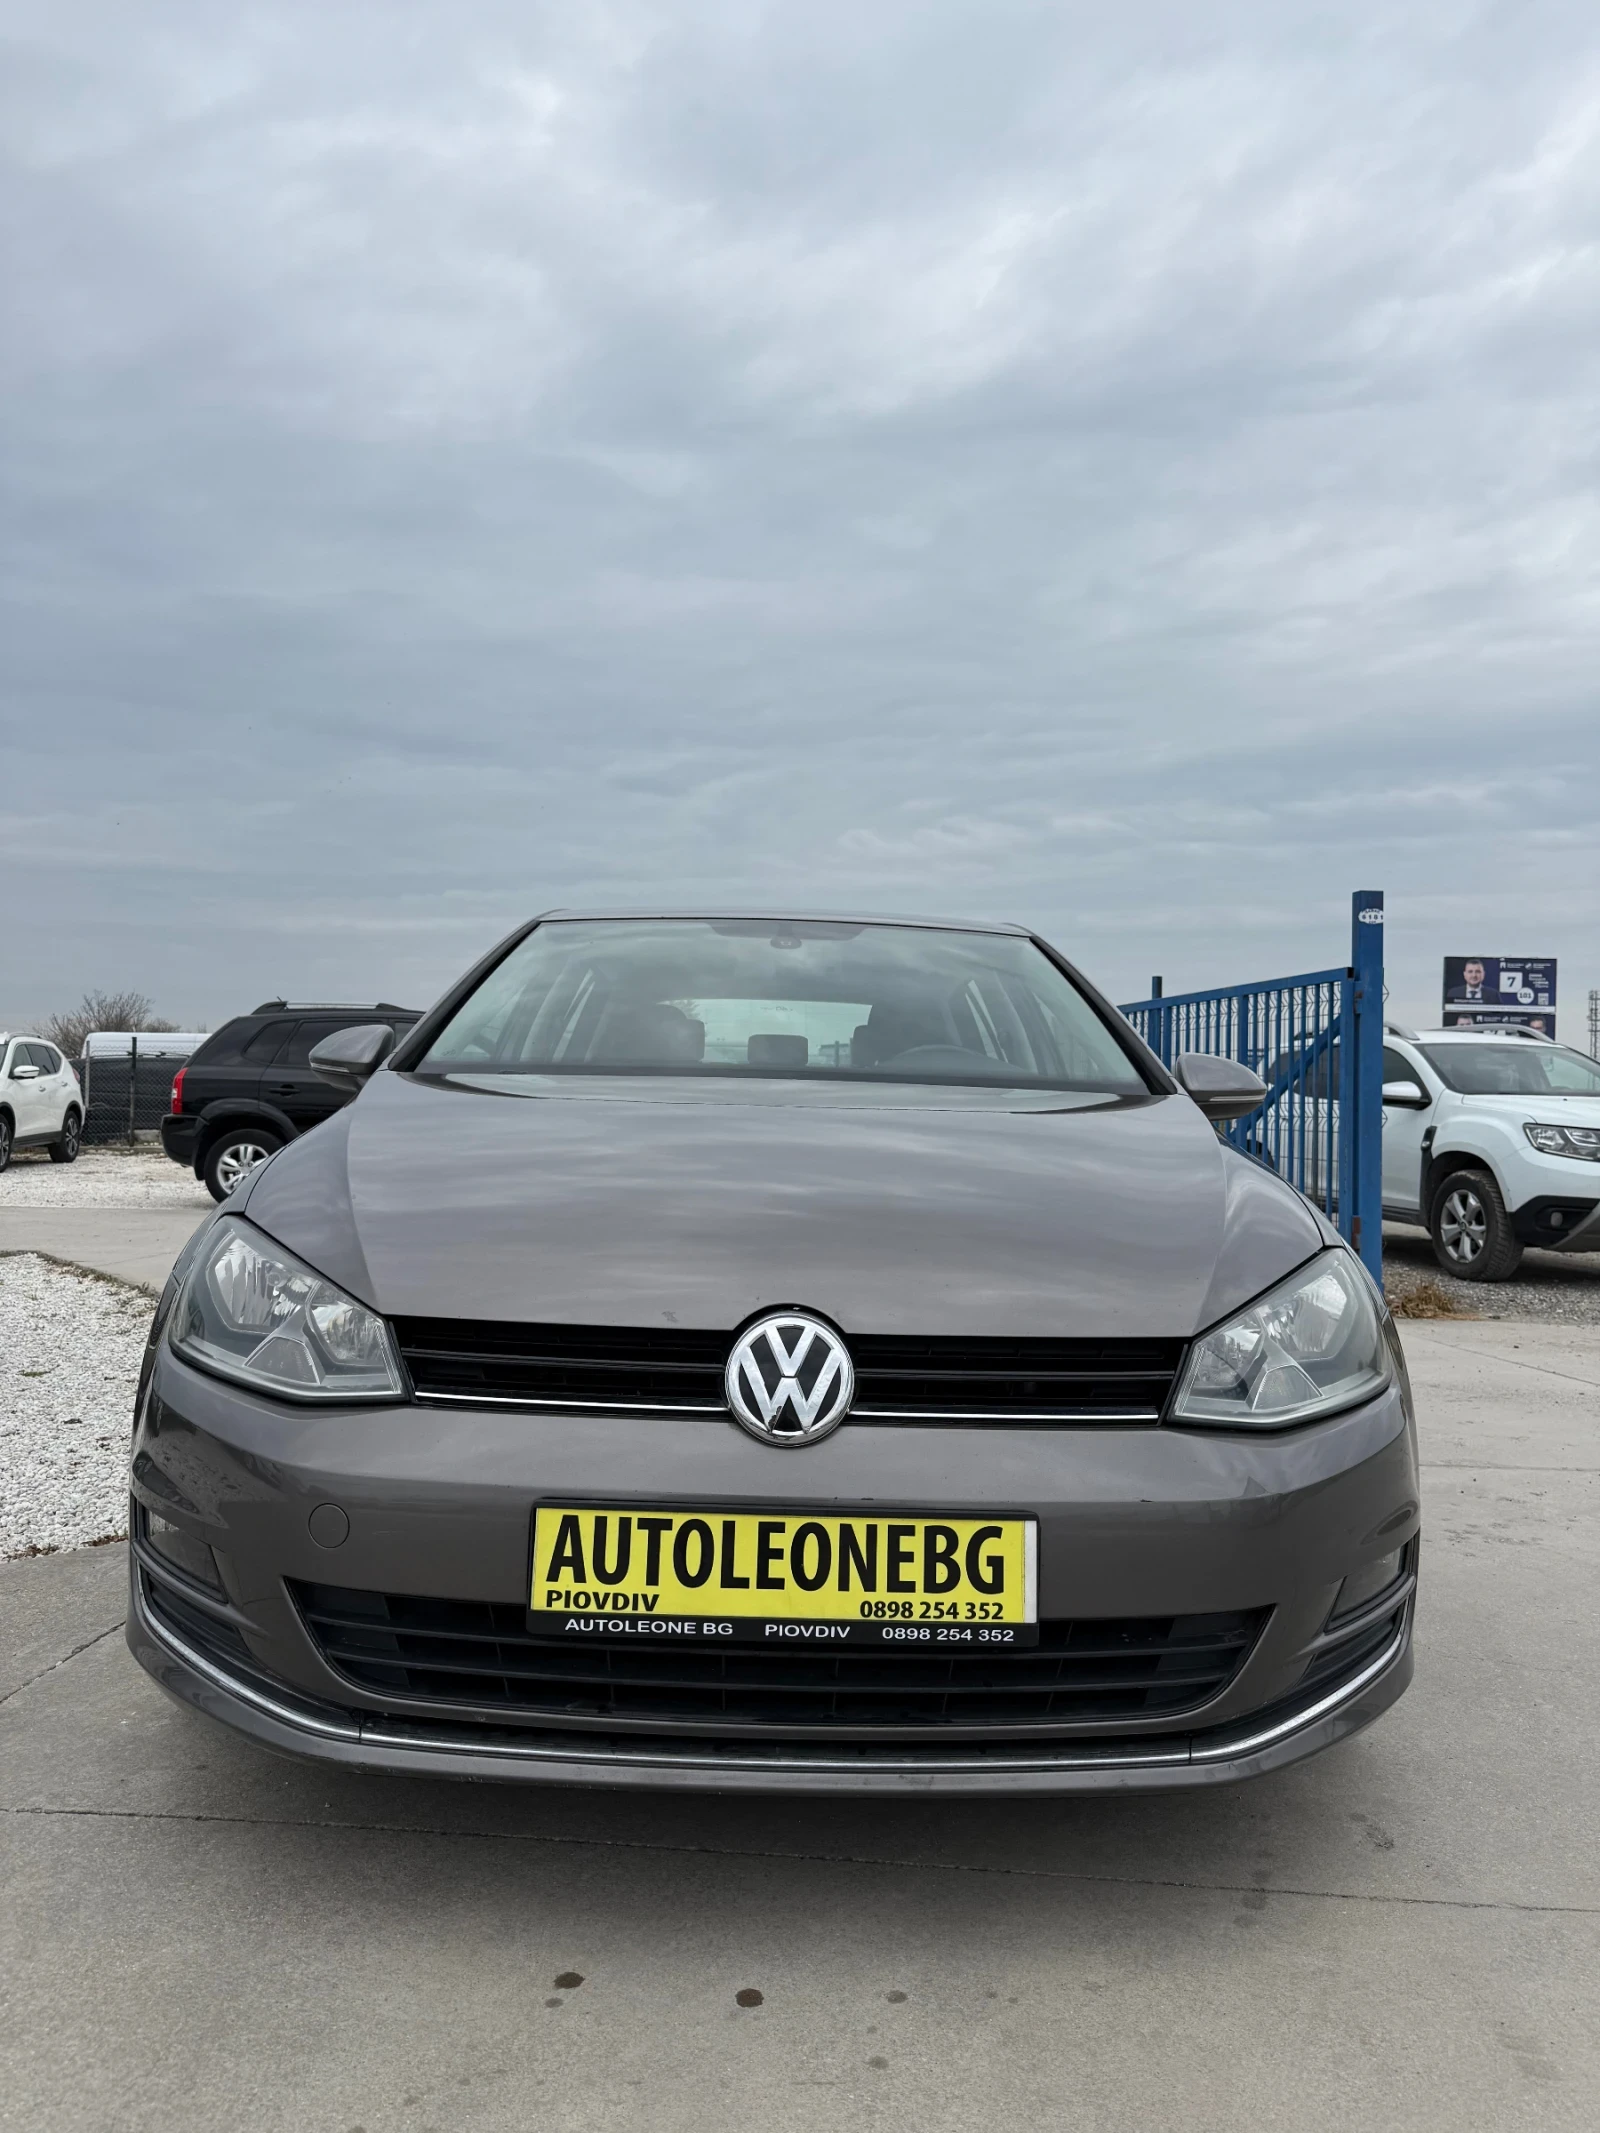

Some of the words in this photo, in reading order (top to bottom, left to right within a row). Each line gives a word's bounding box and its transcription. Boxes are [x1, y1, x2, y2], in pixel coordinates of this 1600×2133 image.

[1506, 976, 1517, 988] 7
[734, 1320, 846, 1436] VW
[546, 1514, 1005, 1595] AUTOLEONEBG
[546, 1589, 660, 1612] PIOVDIV
[859, 1600, 914, 1619] 0898
[919, 1601, 960, 1620] 254
[965, 1602, 1004, 1620] 352
[564, 1618, 697, 1635] AUTOLEONE
[702, 1622, 734, 1636] BG
[764, 1624, 851, 1638] PIOVDIV
[882, 1627, 931, 1640] 0898
[936, 1628, 973, 1641] 254
[978, 1629, 1015, 1642] 352
